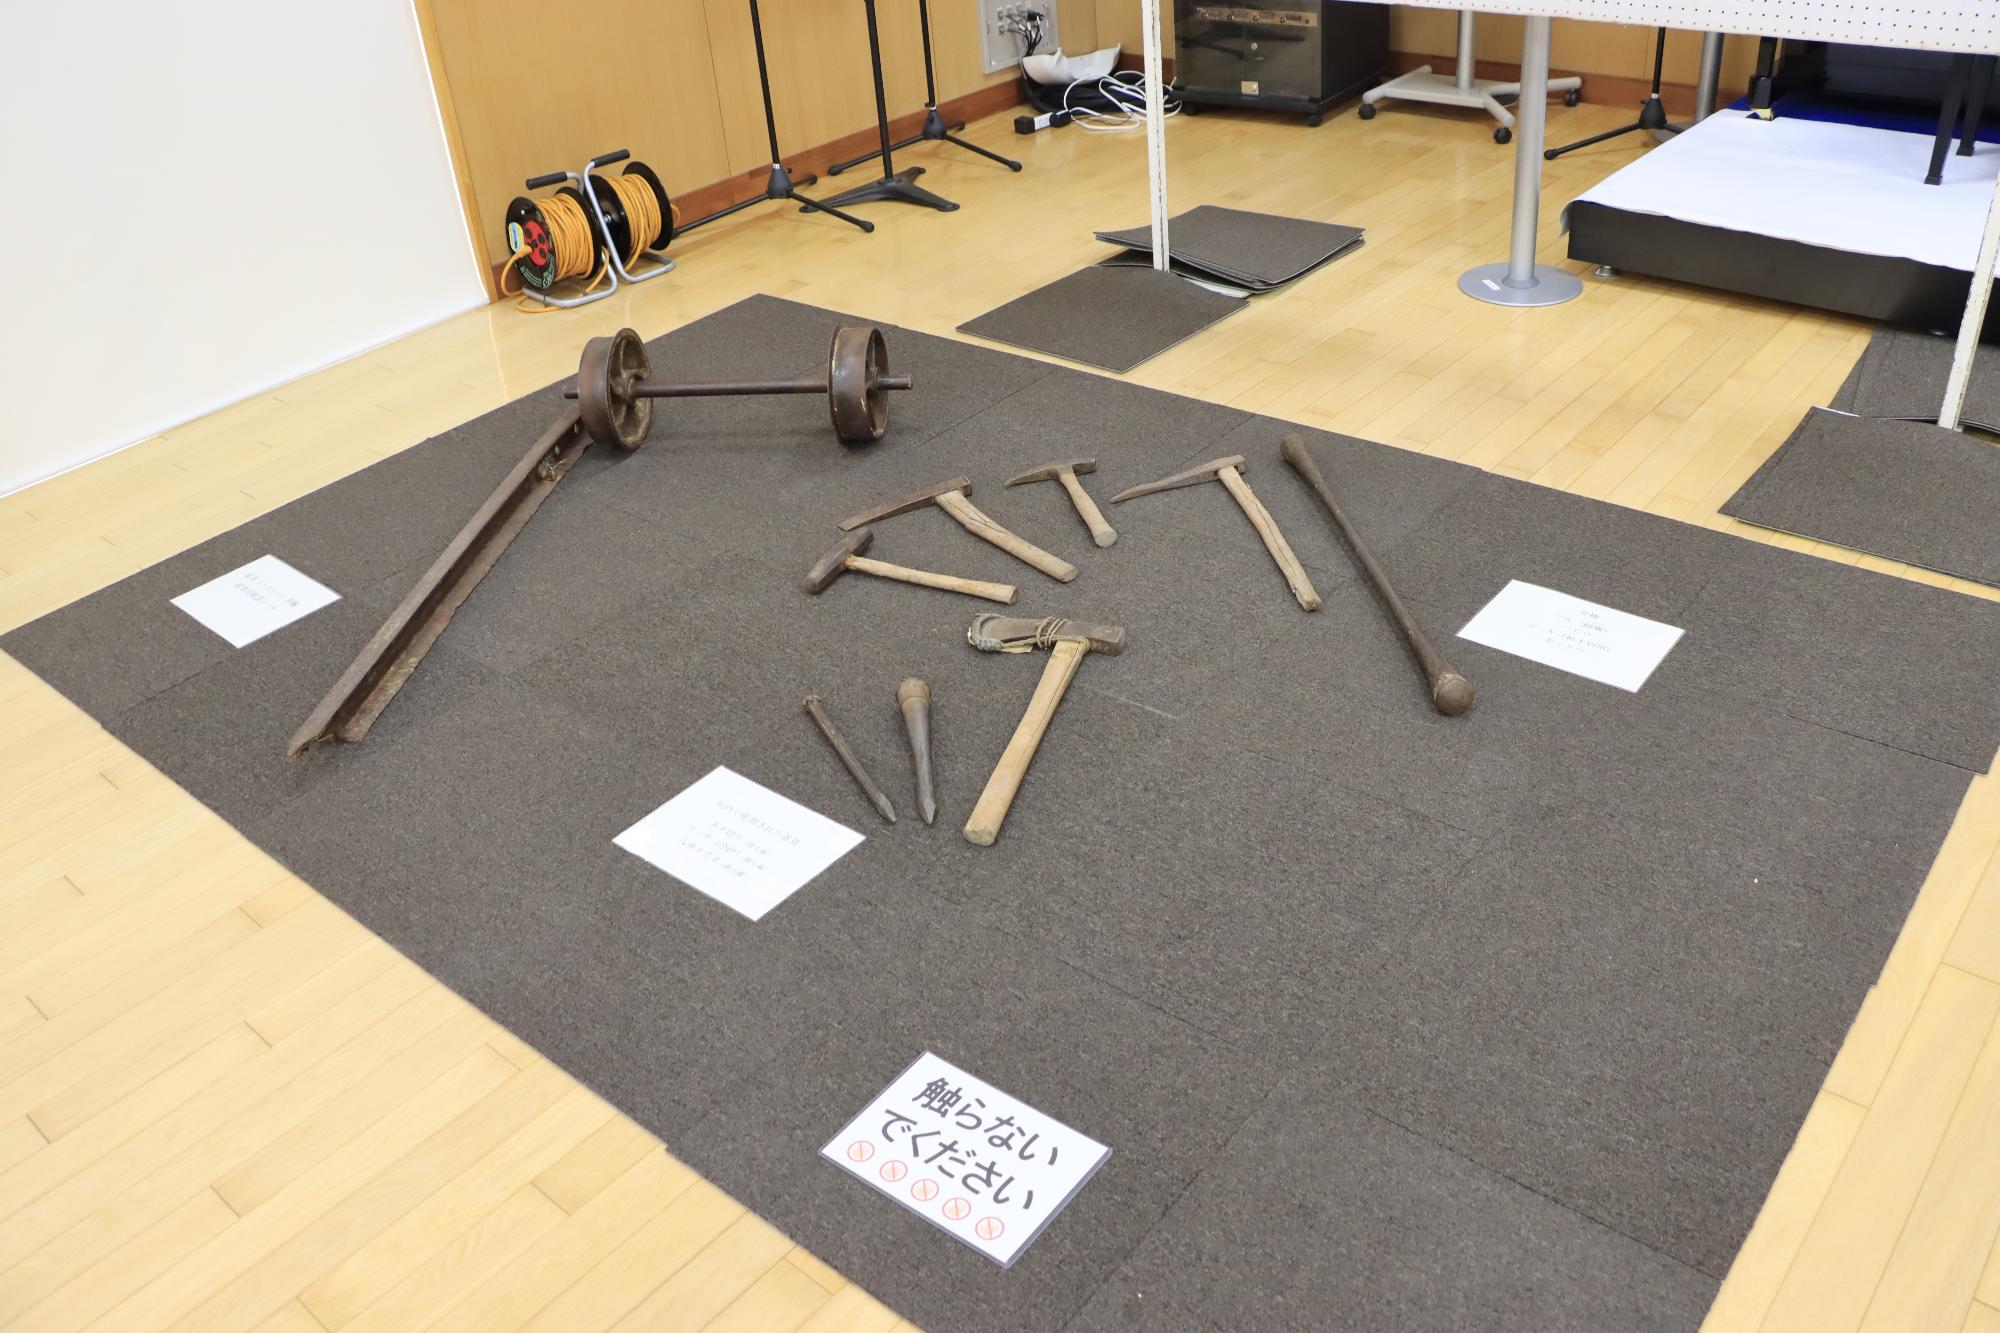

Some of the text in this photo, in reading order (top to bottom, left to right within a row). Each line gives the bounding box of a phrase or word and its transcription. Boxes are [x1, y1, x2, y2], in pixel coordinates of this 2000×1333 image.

[881, 1108, 1034, 1210] でください
[911, 1077, 1058, 1166] 触らない
